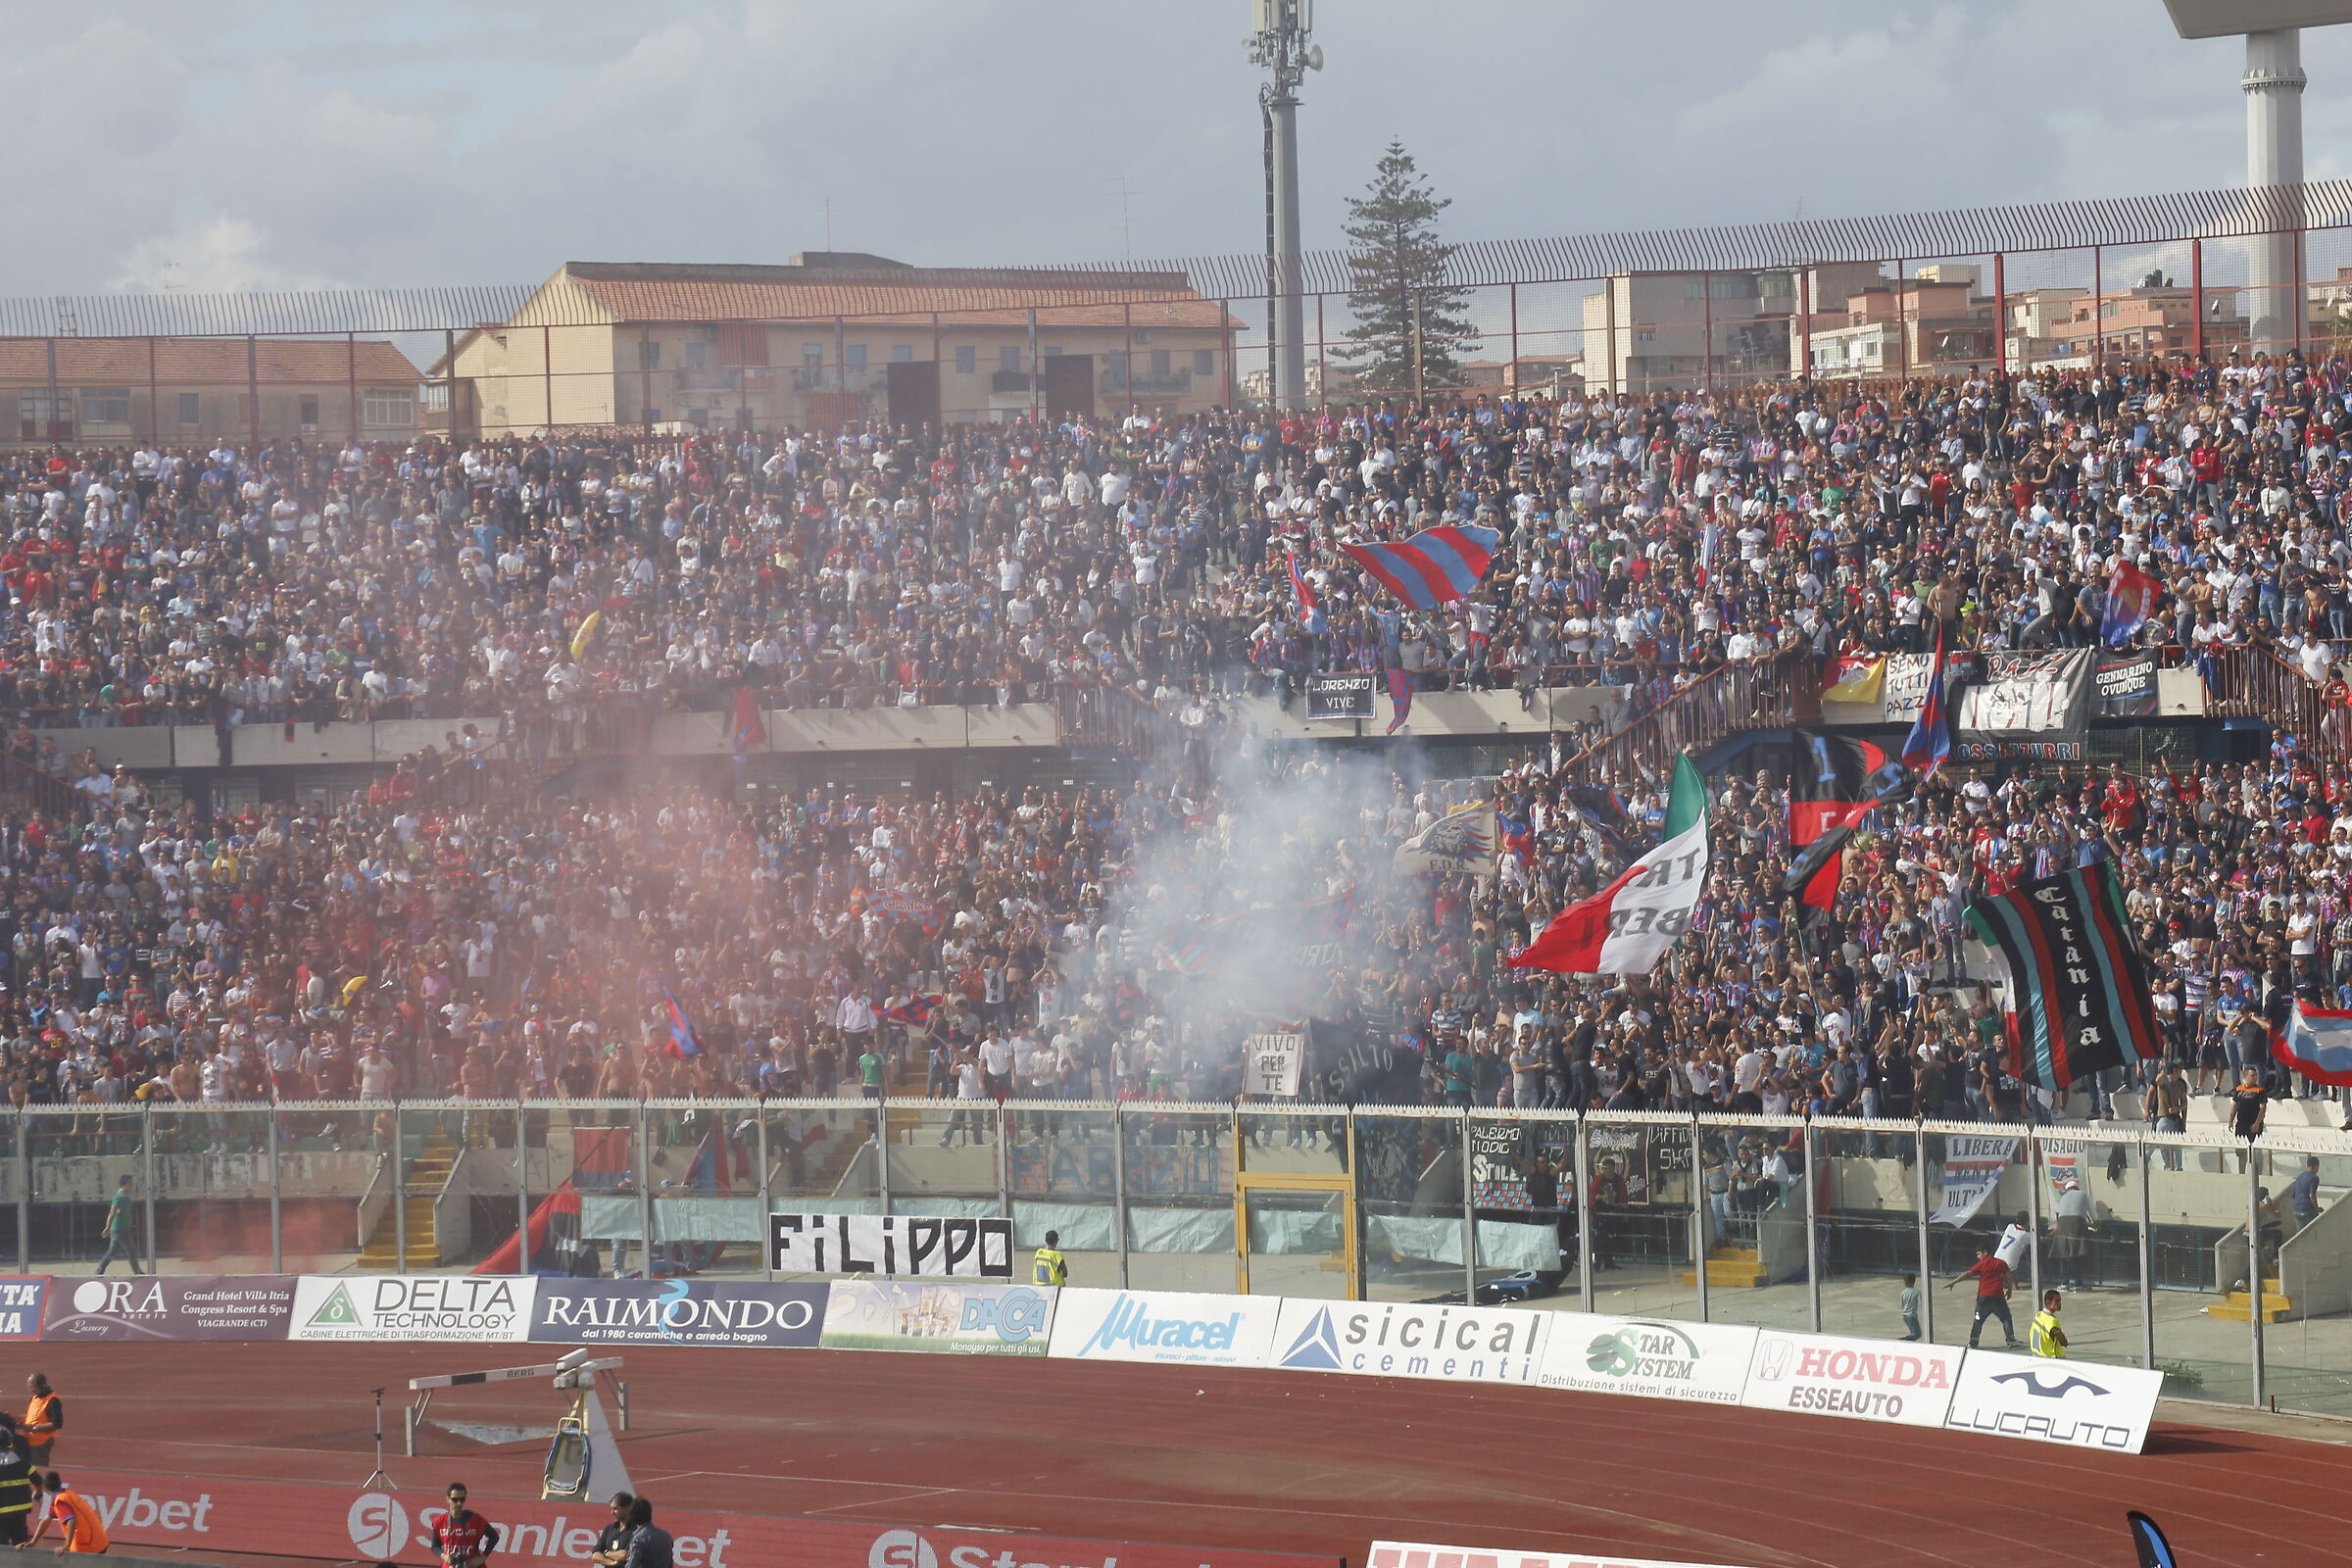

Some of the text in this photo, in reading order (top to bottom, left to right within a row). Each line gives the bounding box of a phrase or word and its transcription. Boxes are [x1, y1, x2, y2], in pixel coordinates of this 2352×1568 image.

[1889, 654, 1931, 674] SEMU
[1987, 652, 2082, 682] PAZZI
[2095, 661, 2153, 685] GENNARINO
[1312, 678, 1370, 692] LORENZO
[1887, 671, 1930, 696] TUTTI
[2101, 675, 2146, 697] OVUNQUE
[1325, 697, 1355, 710] VIVE
[1886, 695, 1926, 717] PAZZ
[1953, 742, 2081, 761] OSSAZZURRI
[1254, 1035, 1297, 1052] VIVO
[1260, 1054, 1286, 1073] PER
[1259, 1073, 1284, 1092] TE
[1952, 1138, 2014, 1157] LIBERA
[2002, 1235, 2016, 1250] 7
[183, 1291, 290, 1301] Grand Hotel Villa Itria
[373, 1279, 516, 1312] DELTA
[181, 1304, 288, 1317] Congress Resort & Spa
[542, 1296, 813, 1330] RAIMONDO
[197, 1319, 268, 1328] VIAGRANDE (CT)
[372, 1312, 517, 1330] TECHNOLOGY
[1076, 1293, 1241, 1357] Muracel
[1345, 1305, 1542, 1354] sicical
[300, 1330, 514, 1341] CABINE ELETTRICHE DI TRASFORMAZIONE MT/BT
[581, 1328, 599, 1339] dal
[601, 1329, 625, 1340] 1980
[627, 1329, 684, 1341] ceramiche
[696, 1330, 731, 1342] arredo
[733, 1331, 767, 1344] bagno
[951, 1341, 1042, 1356] Monouso per tutti gli usi.
[1352, 1351, 1531, 1381] cementi
[1795, 1348, 1949, 1390] HONDA
[1541, 1373, 1738, 1402] Distribuzione sistemi di sicurezza
[1788, 1385, 1903, 1418] ESSEAUTO
[1948, 1405, 2131, 1448] LUCAUTO
